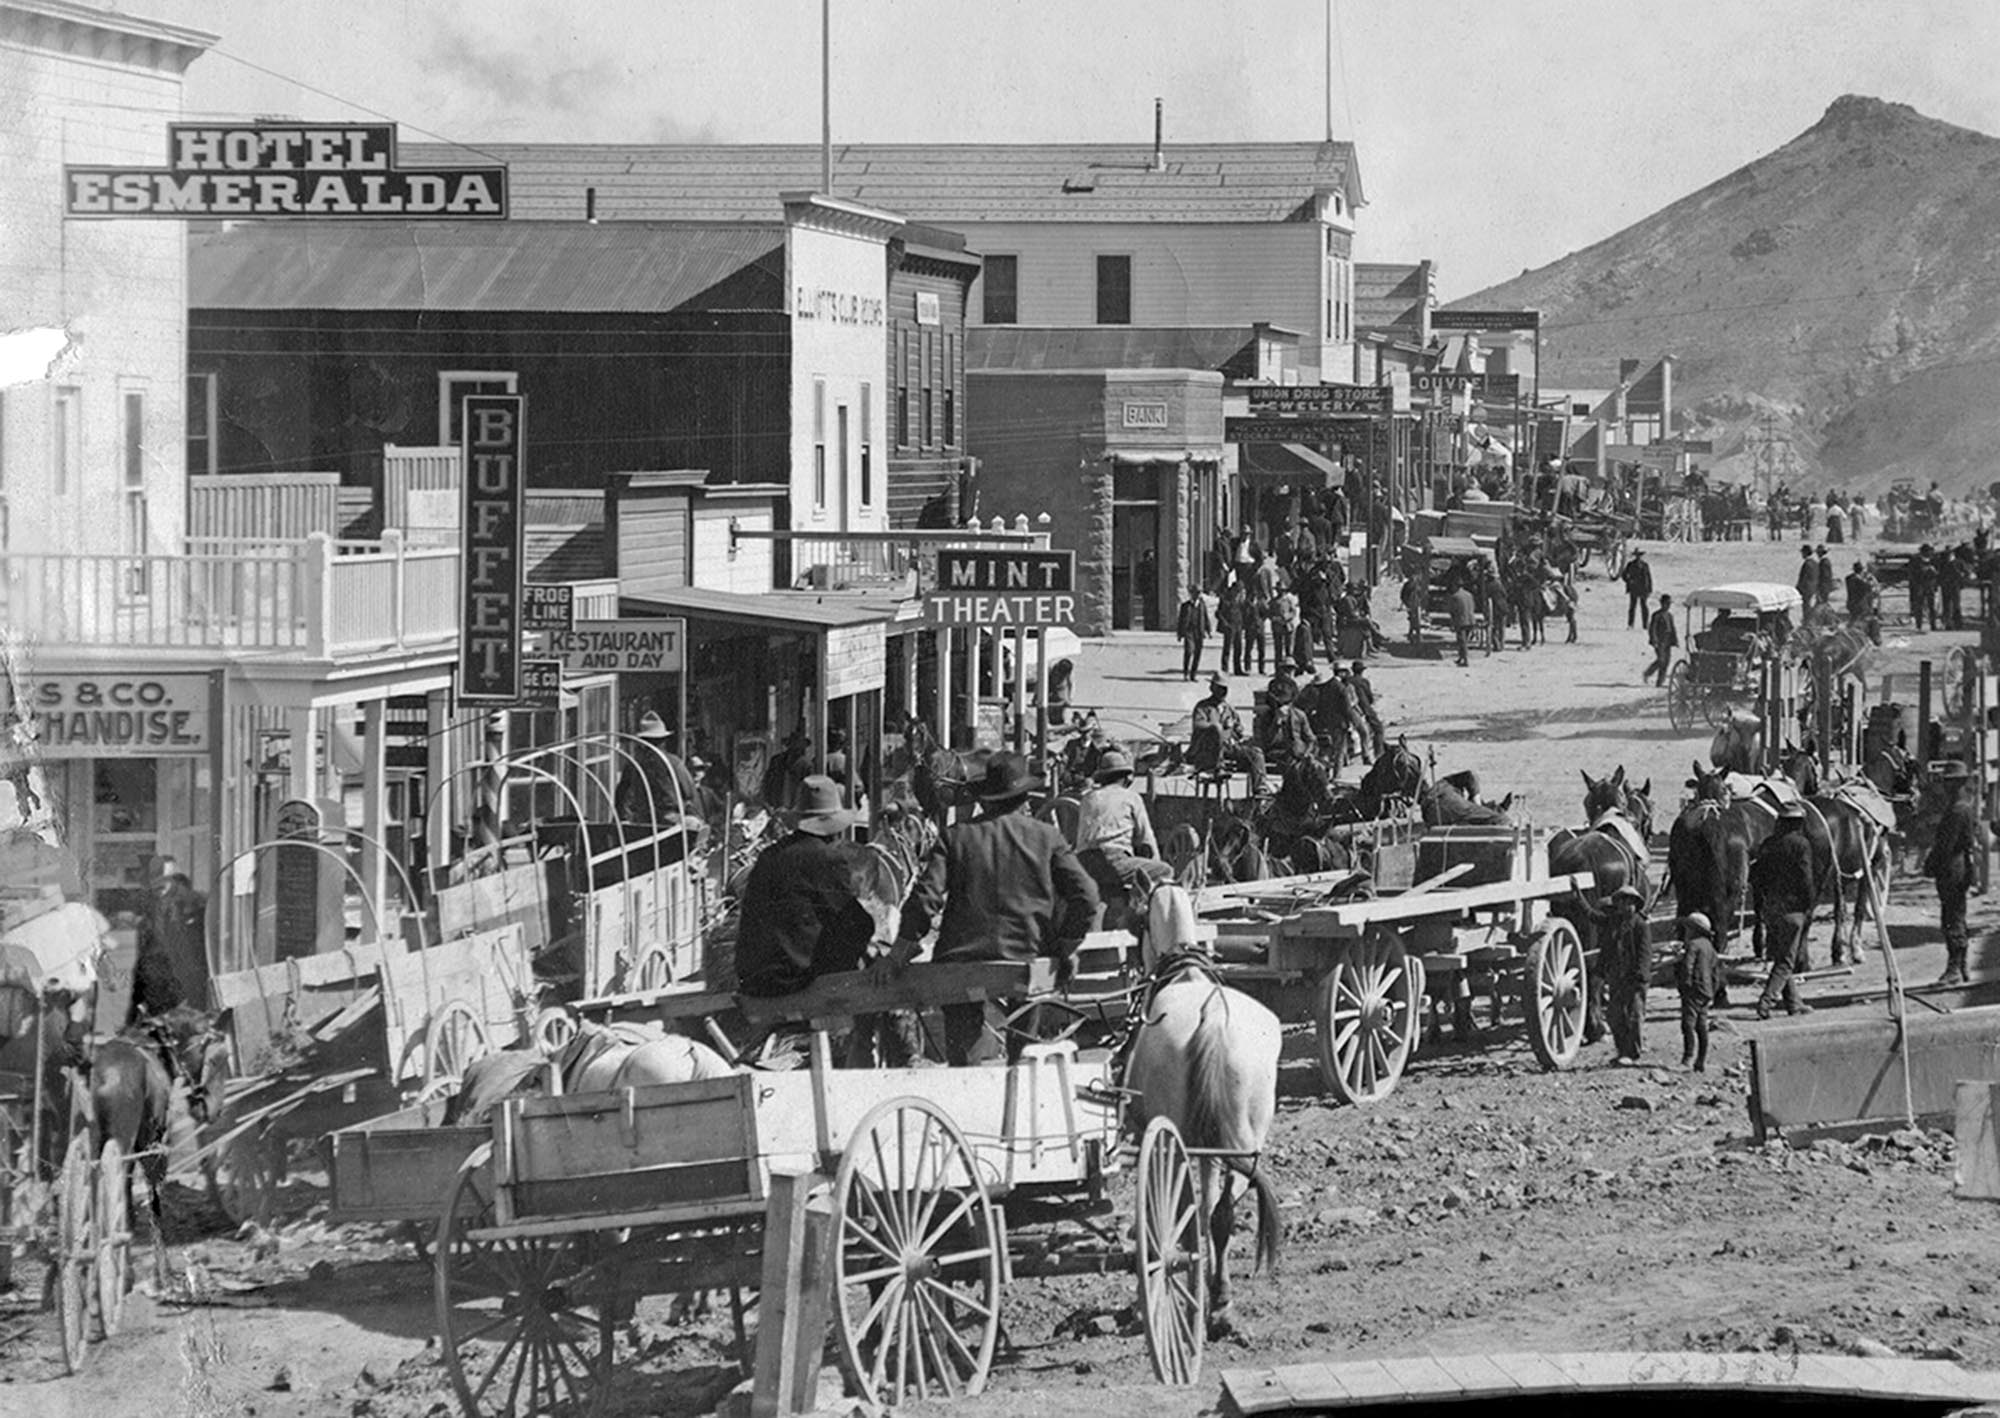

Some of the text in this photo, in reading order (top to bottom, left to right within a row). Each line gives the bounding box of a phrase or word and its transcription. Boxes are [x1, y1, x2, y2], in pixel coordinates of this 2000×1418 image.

[176, 131, 386, 170] HOTEL
[71, 174, 500, 211] ESMERALDA
[1253, 388, 1290, 399] UNION
[1293, 388, 1330, 399] DRUG
[1128, 406, 1164, 426] BANK
[471, 408, 513, 679] BUFFET
[952, 560, 1060, 588] MINT
[523, 587, 570, 603] FROG
[532, 605, 569, 619] LINE
[931, 596, 1075, 622] THEATER
[581, 653, 619, 668] AND
[627, 653, 664, 668] DAY
[76, 682, 103, 706] &
[109, 682, 173, 706] CO.
